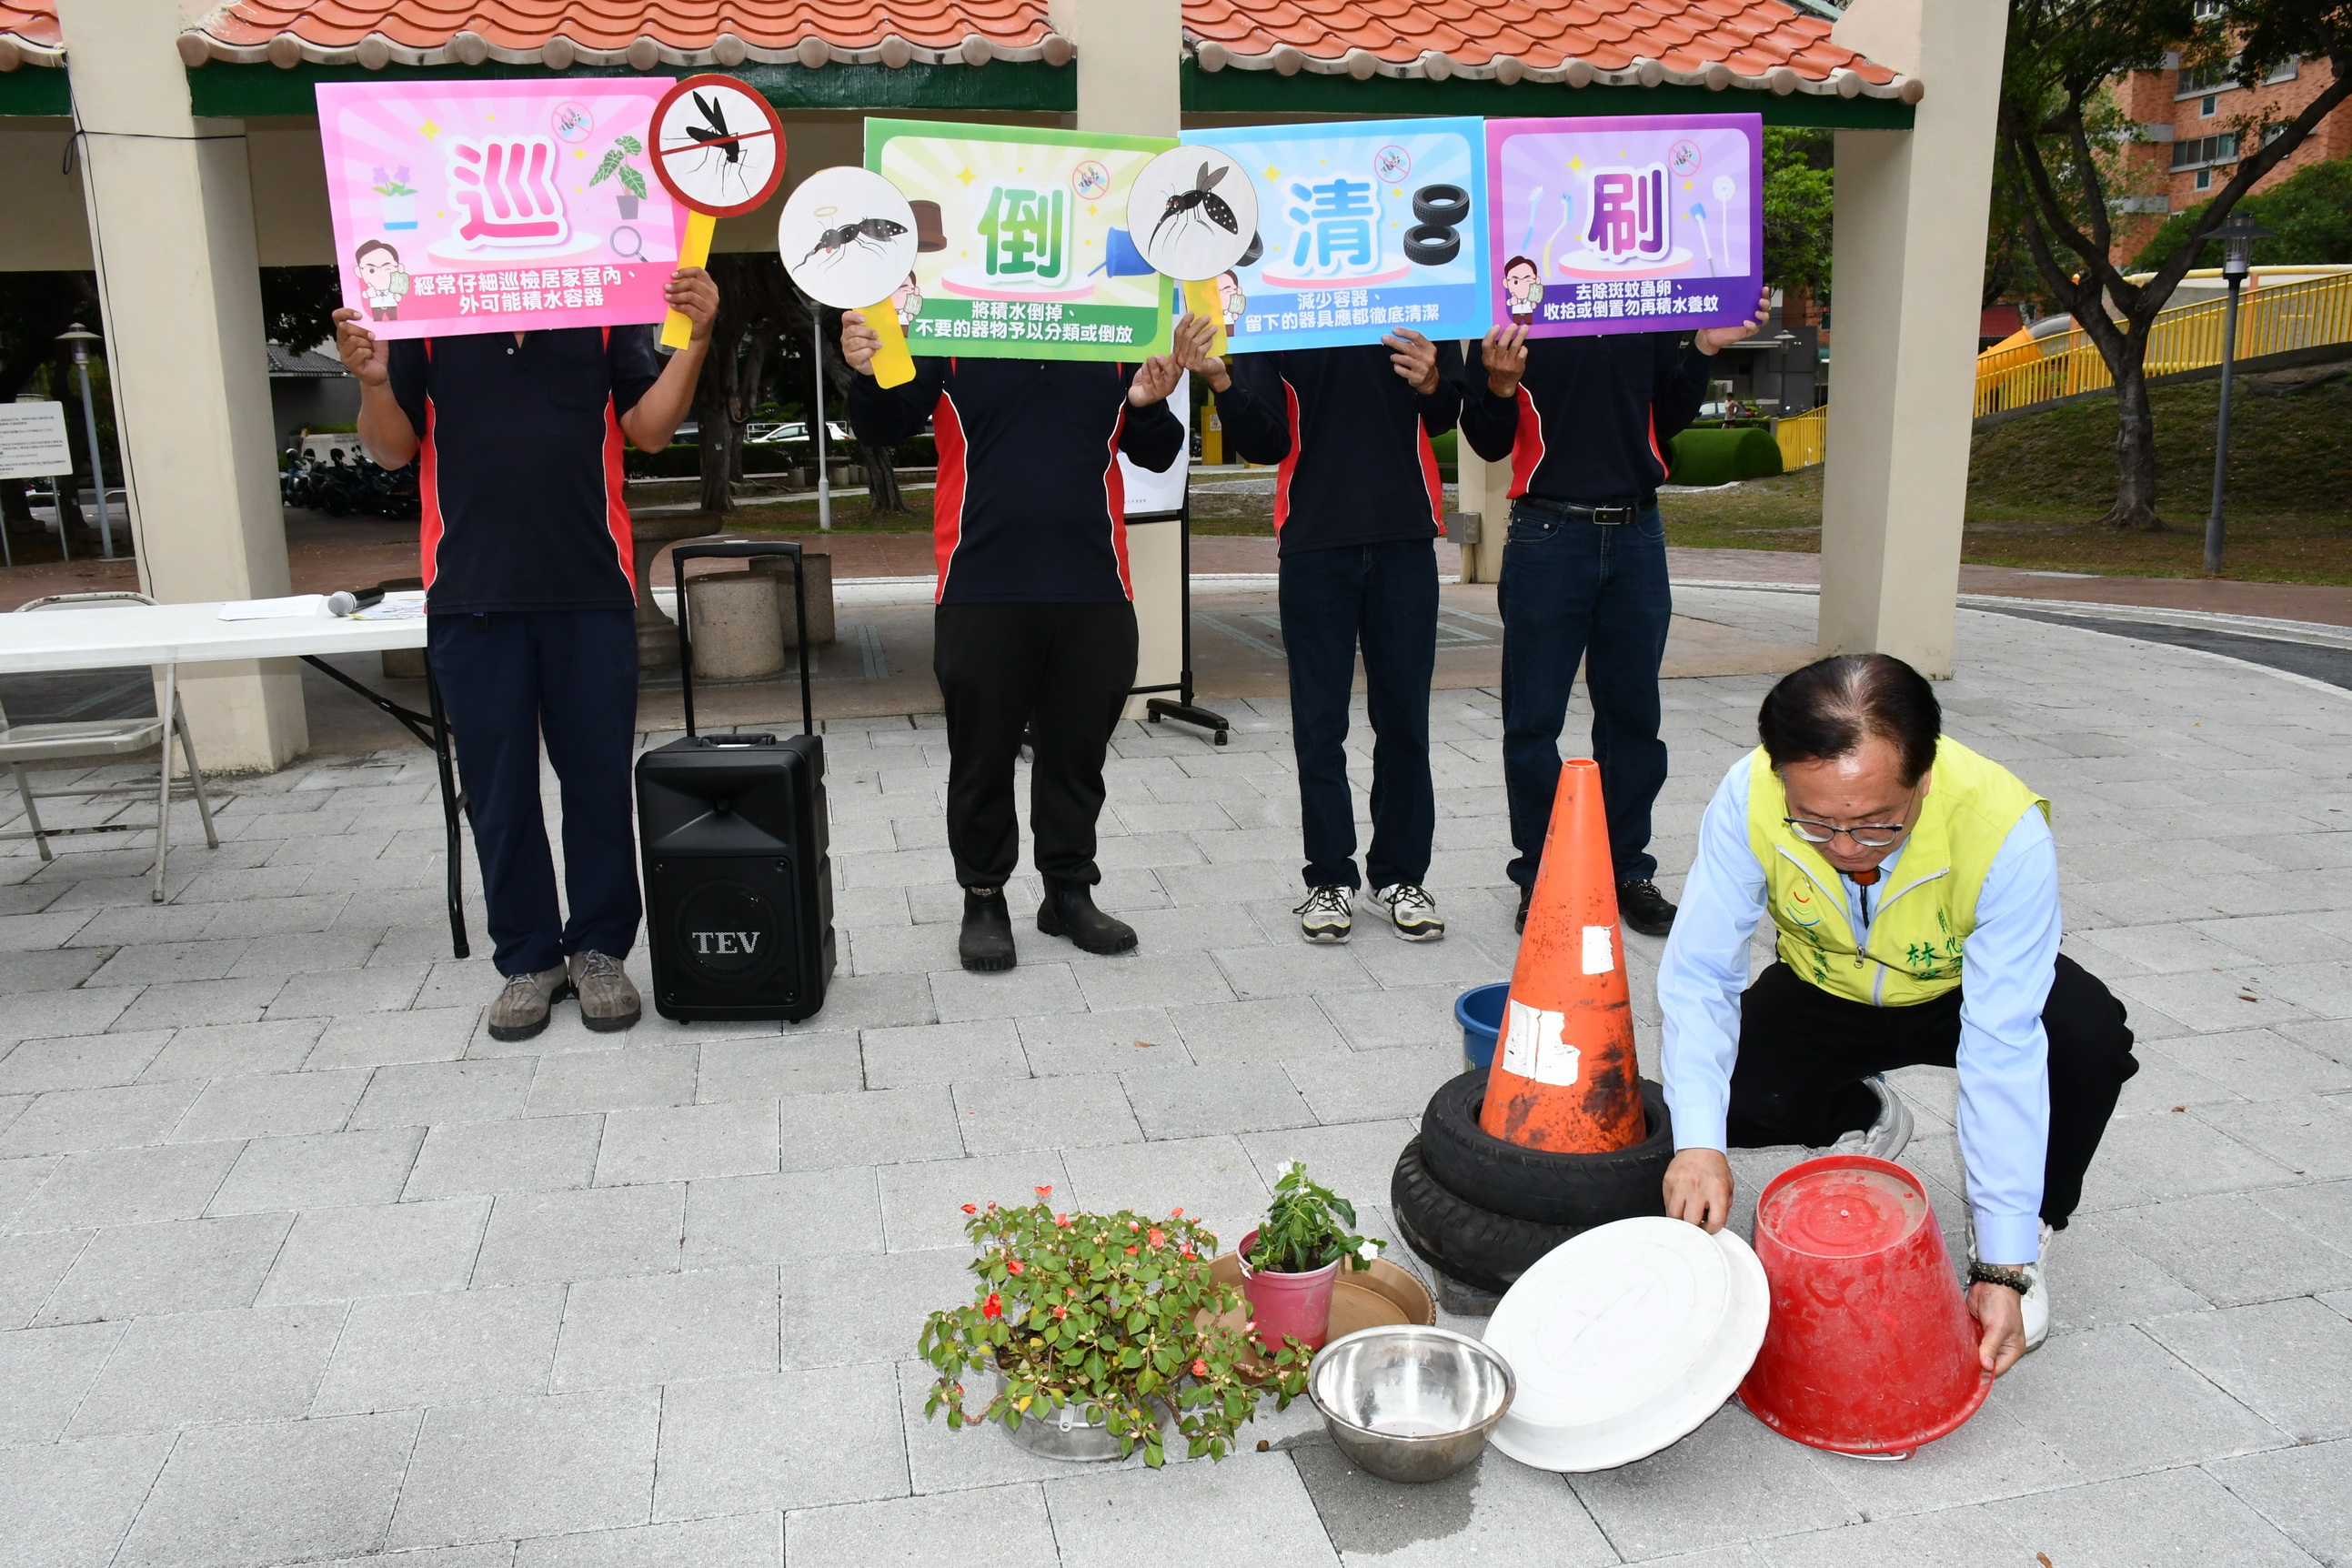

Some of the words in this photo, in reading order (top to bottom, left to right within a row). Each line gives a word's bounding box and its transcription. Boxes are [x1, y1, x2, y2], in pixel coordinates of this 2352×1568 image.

[453, 142, 560, 239] 巡
[1288, 178, 1374, 267] 清
[1587, 169, 1663, 256] 刷
[977, 185, 1065, 278] 倒
[458, 287, 605, 315] 外可能積水容器
[1543, 295, 1719, 321] 收拾或倒置勿再積水養蚊
[915, 318, 1133, 344] 不要的器物予以分類或倒放
[1245, 304, 1440, 333] 留下的器具應都徹底清潔
[691, 931, 760, 954] TEV
